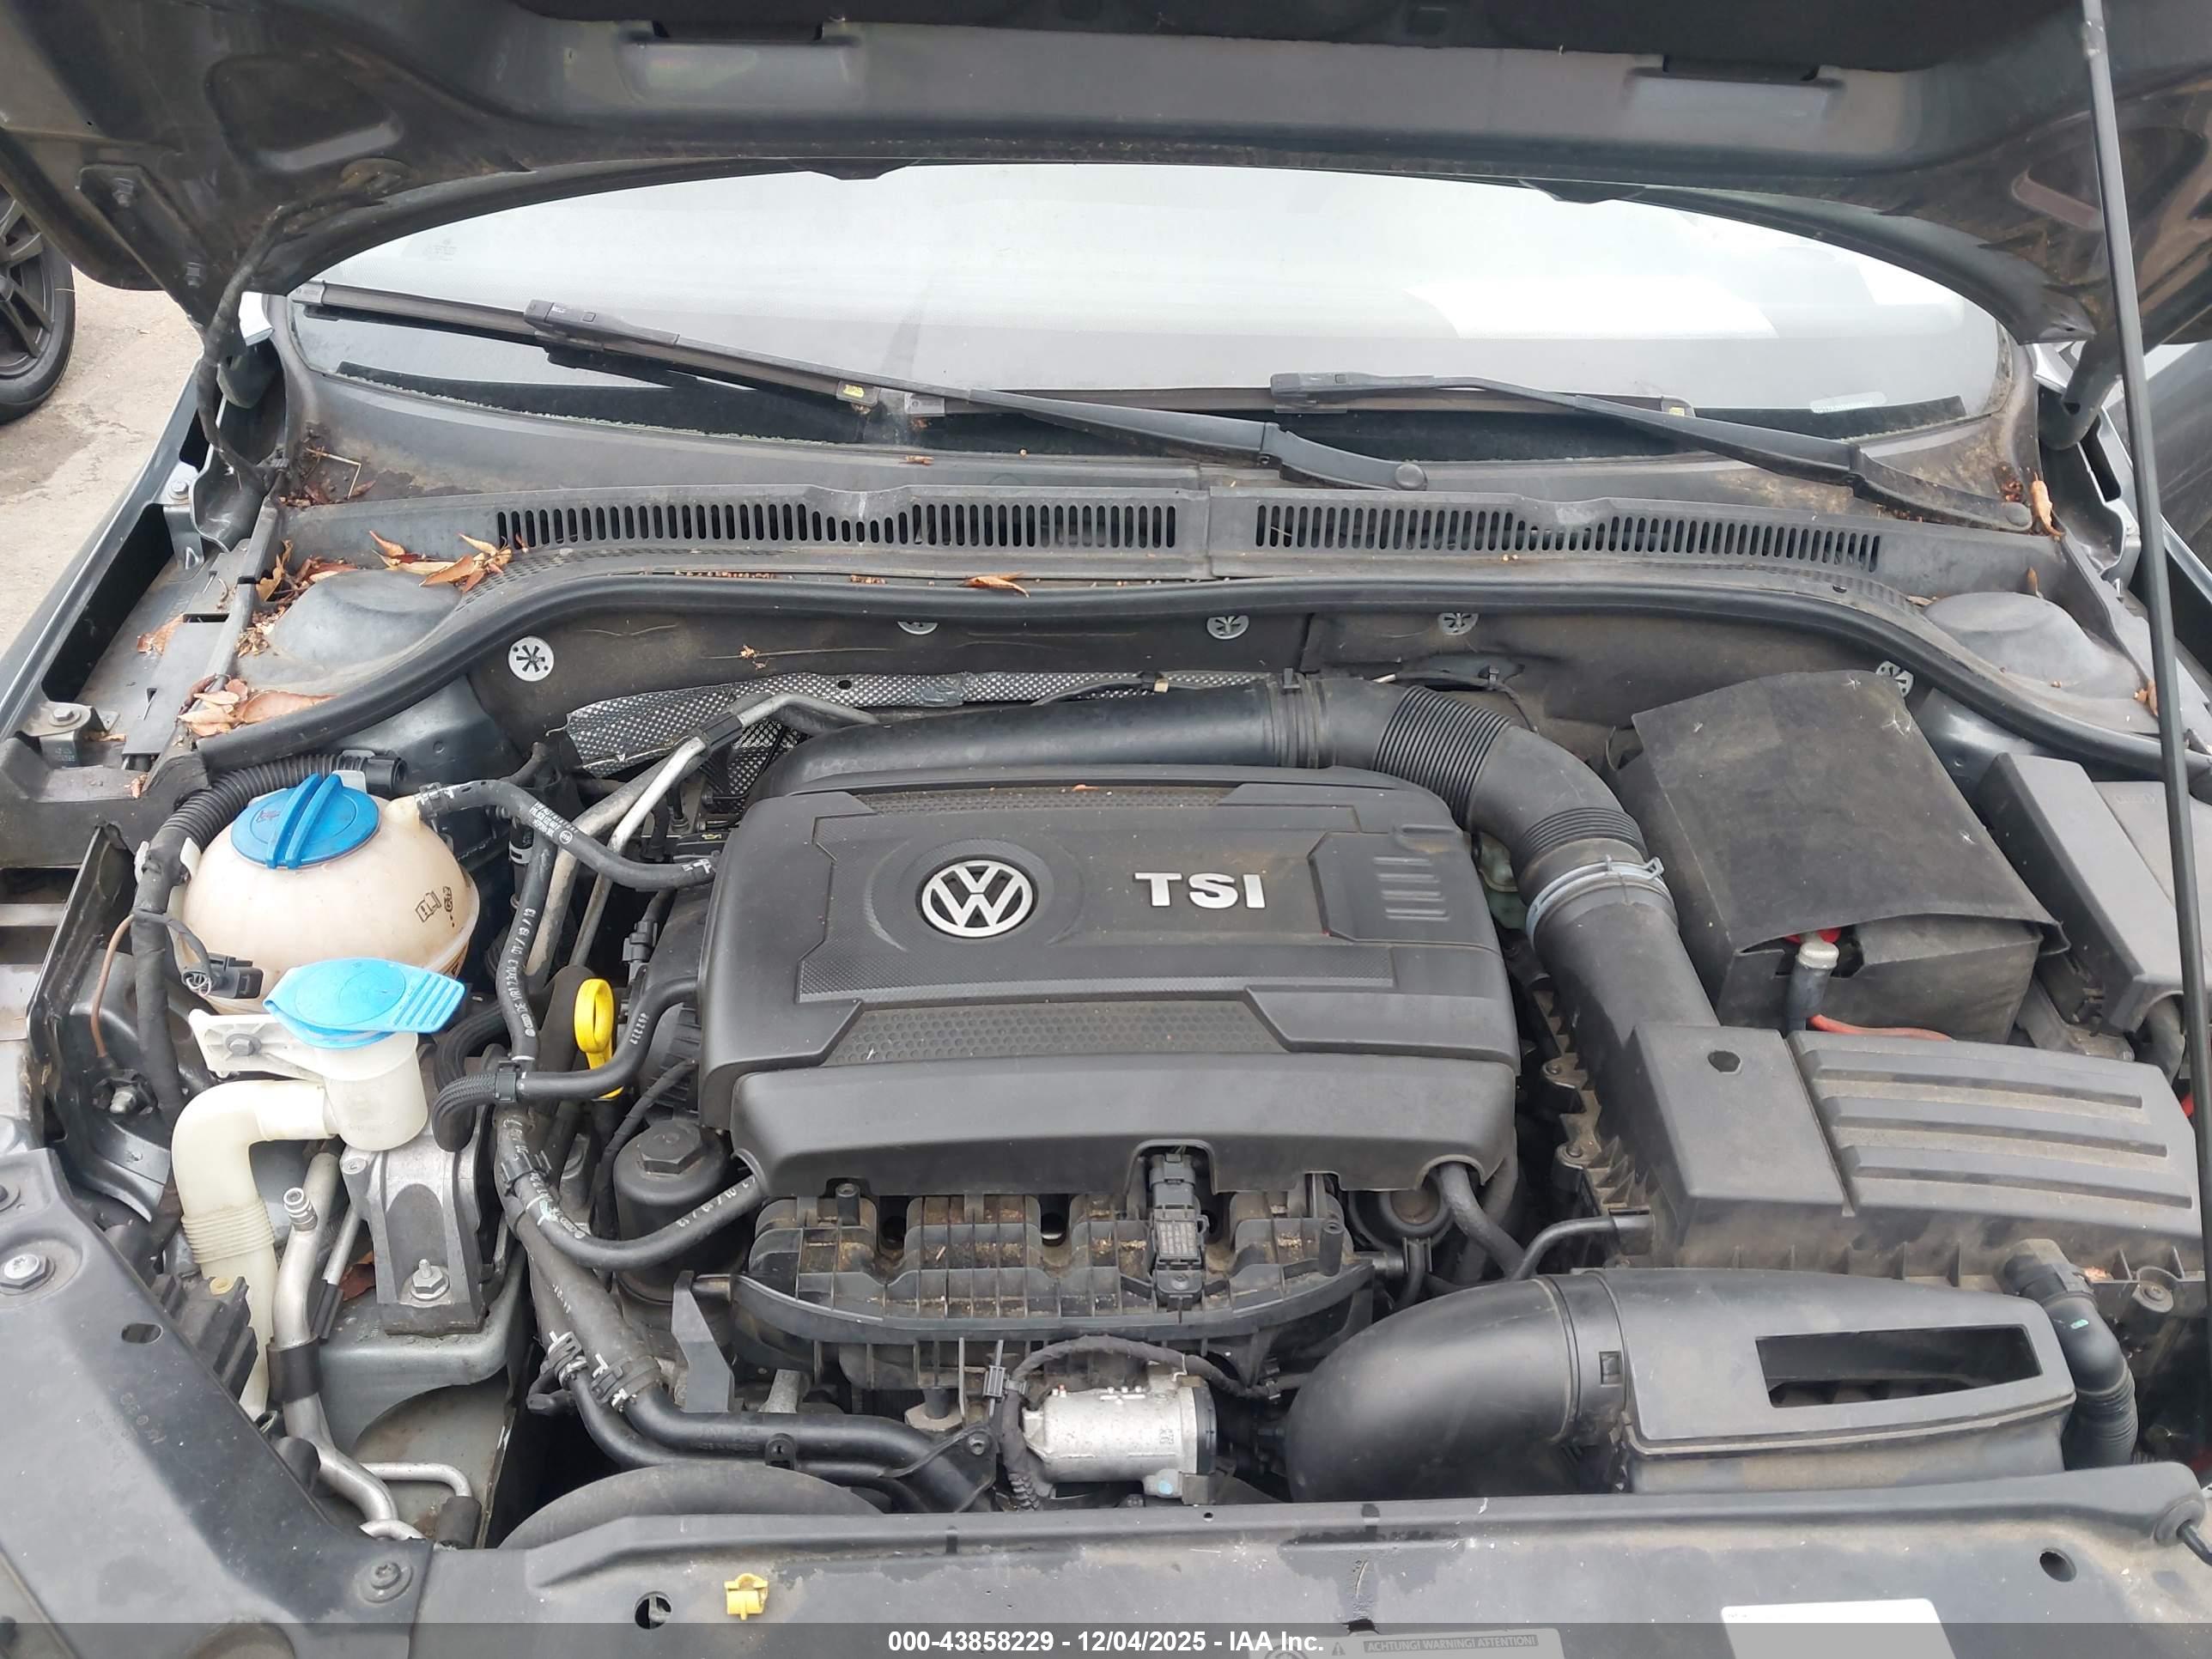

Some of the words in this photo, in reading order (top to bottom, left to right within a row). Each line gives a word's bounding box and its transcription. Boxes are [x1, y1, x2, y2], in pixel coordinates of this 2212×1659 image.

[1134, 872, 1267, 909] TSI
[1367, 1641, 1421, 1652] ACHTUNG!
[1422, 1638, 1476, 1650] WARNING!
[1477, 1635, 1537, 1647] ATTENTION!
